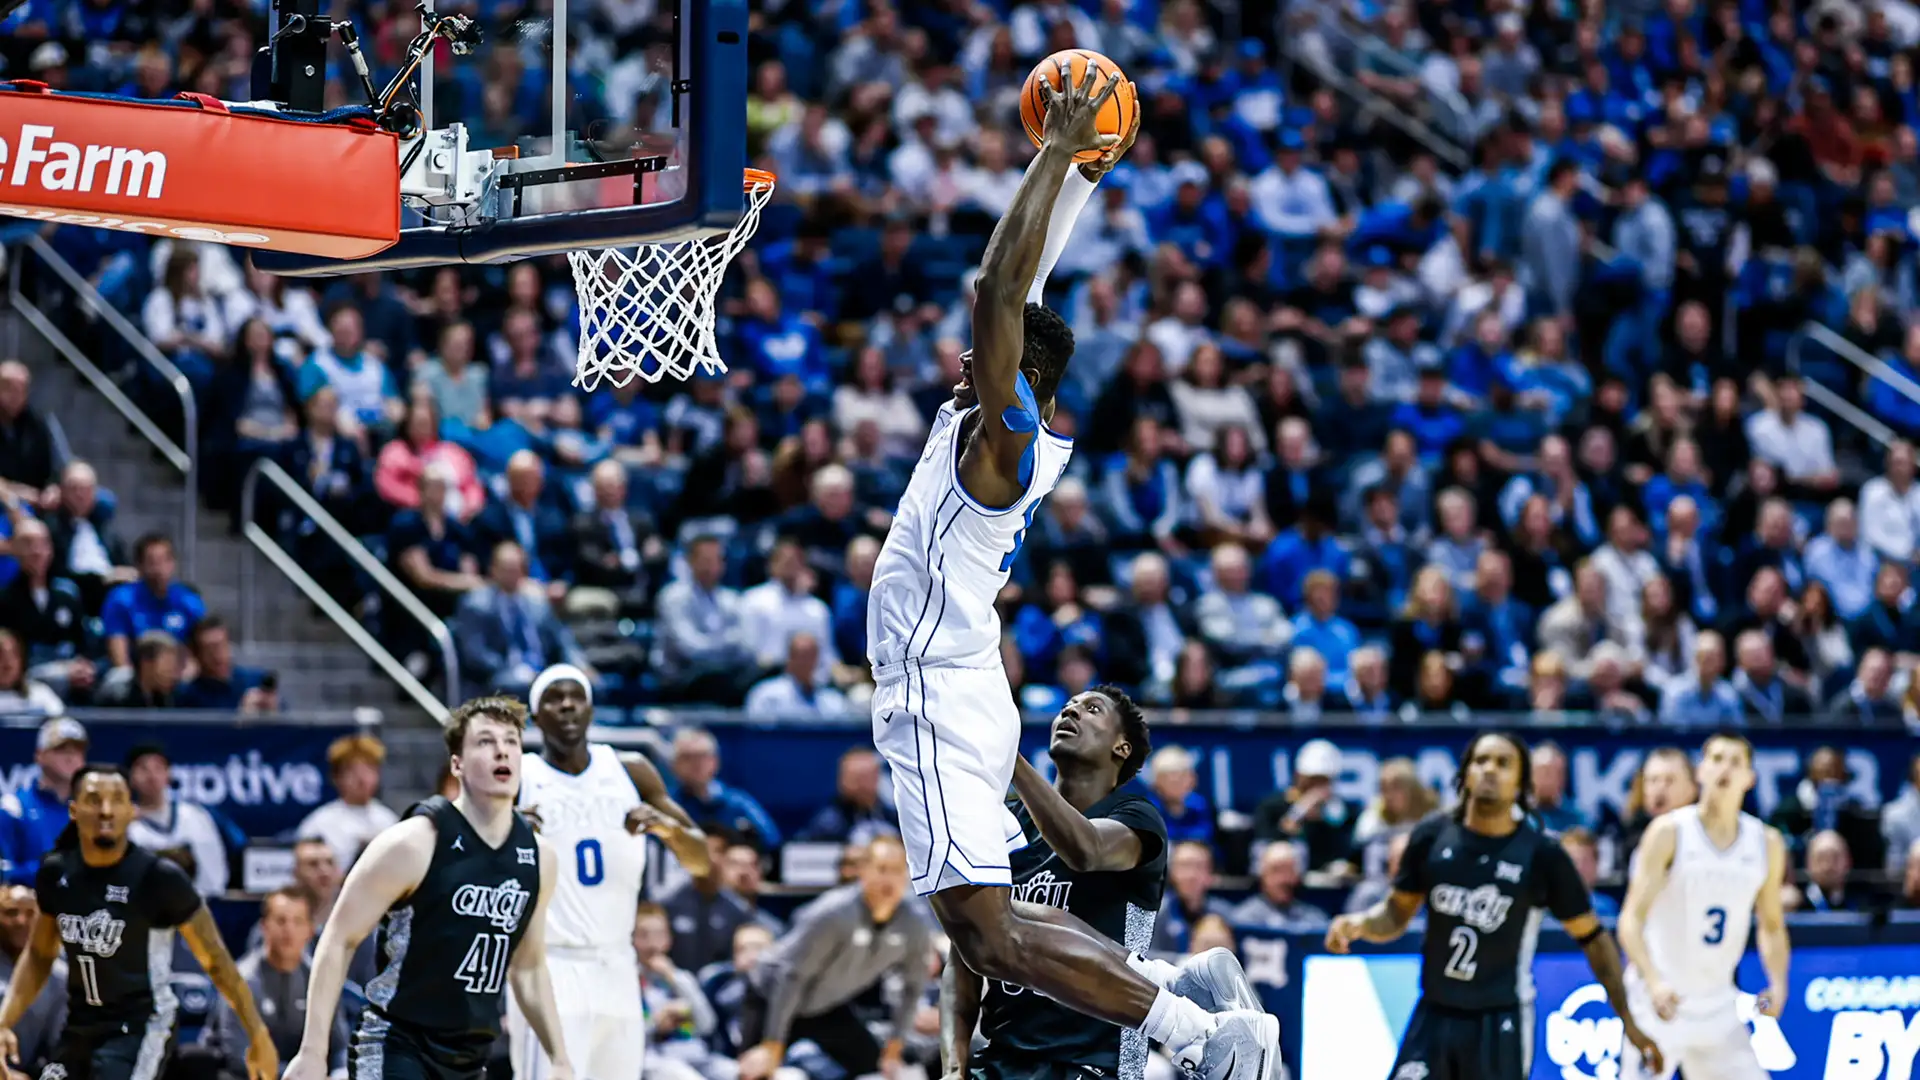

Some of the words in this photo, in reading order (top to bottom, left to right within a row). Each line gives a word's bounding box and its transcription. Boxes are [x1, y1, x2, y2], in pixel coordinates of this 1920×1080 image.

[11, 124, 168, 198] Farm
[576, 839, 604, 887] 0
[1703, 906, 1727, 945] 3
[76, 954, 104, 1006] 1
[453, 933, 510, 994] 41
[1443, 926, 1479, 981] 2
